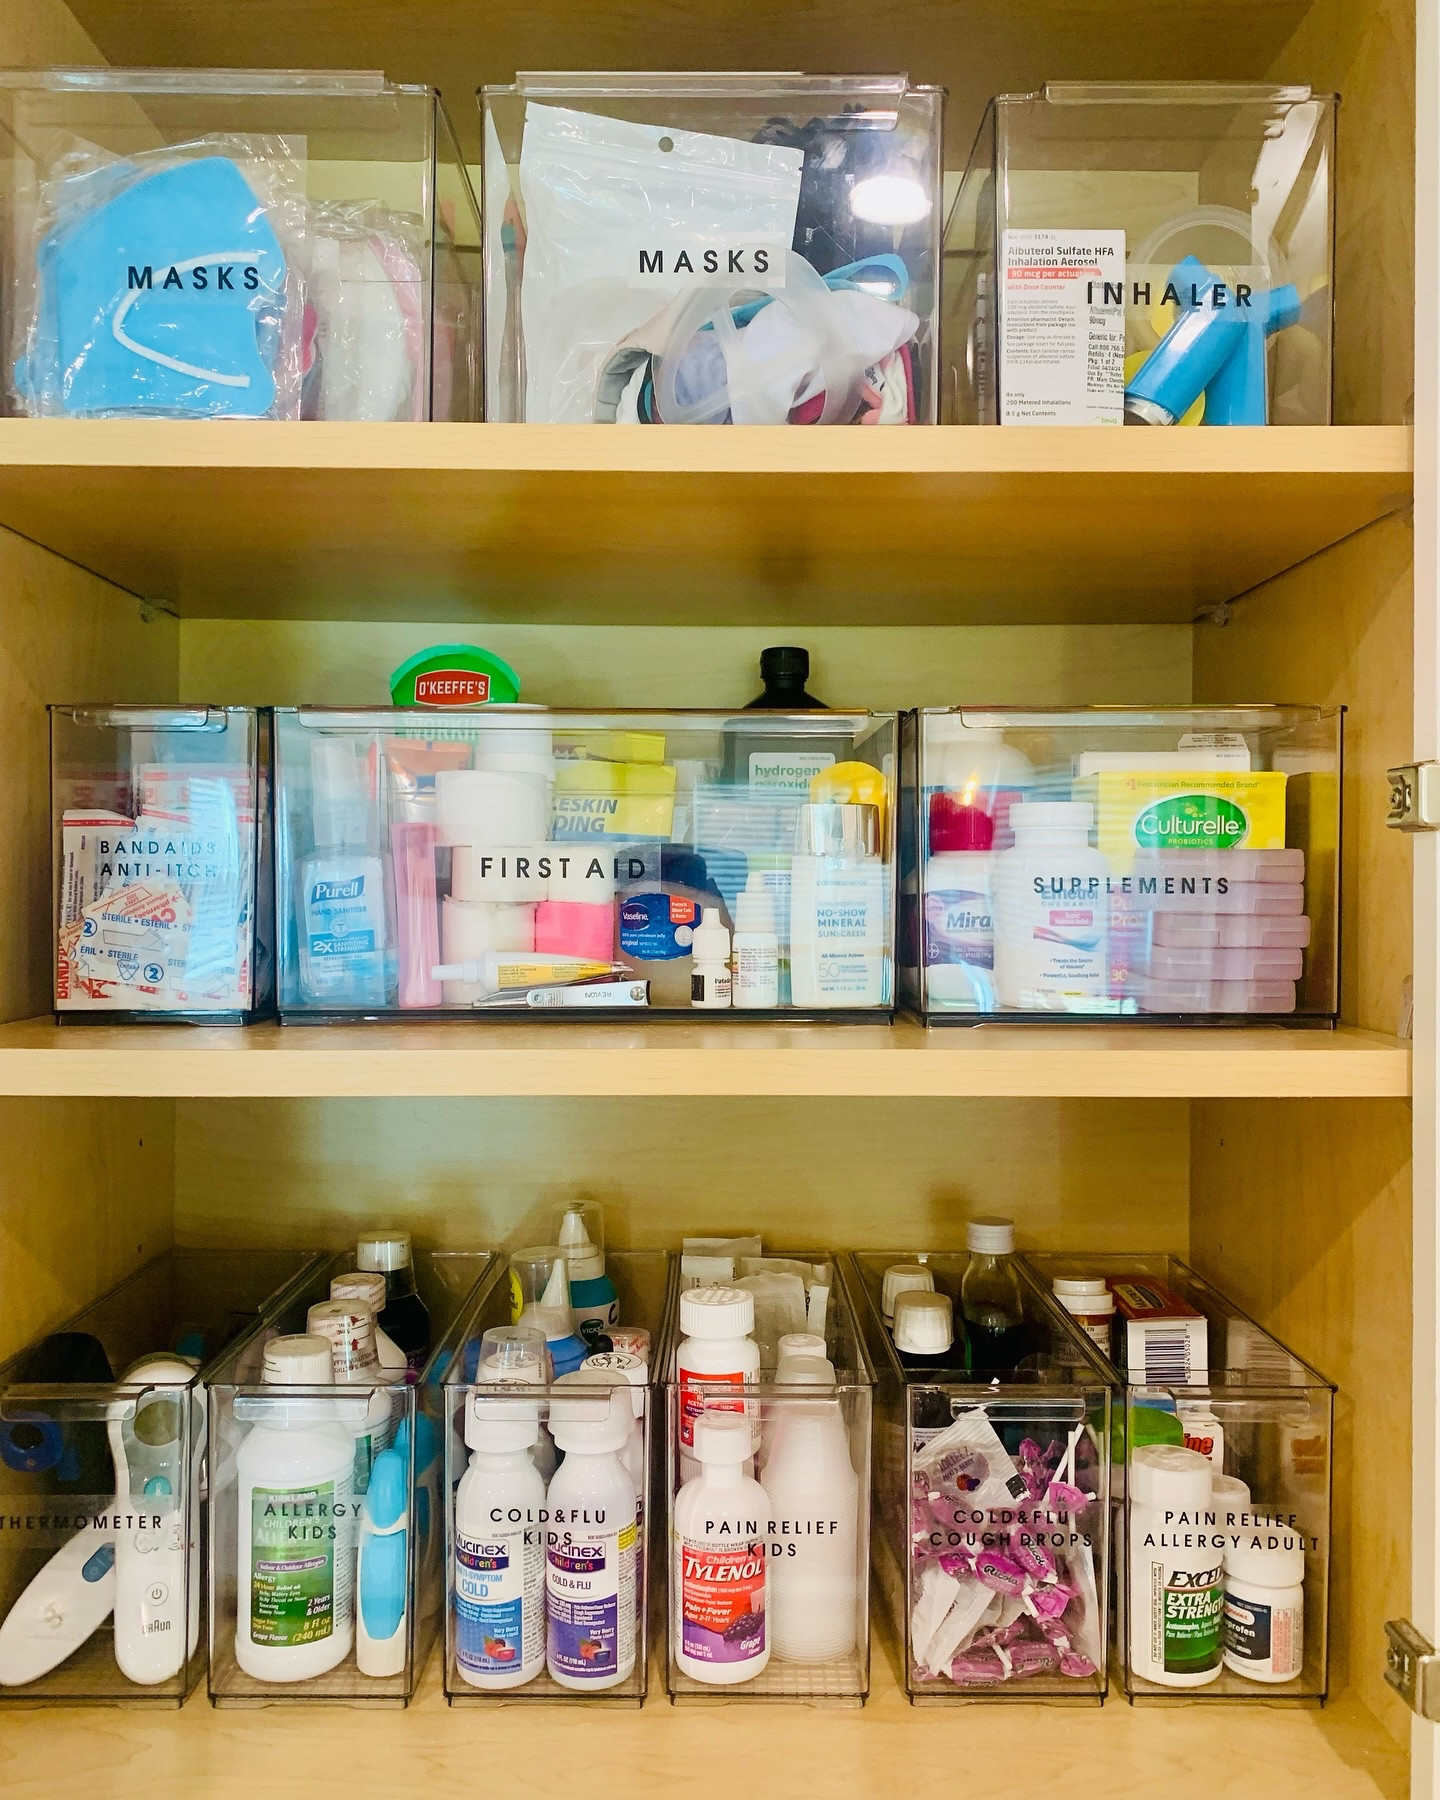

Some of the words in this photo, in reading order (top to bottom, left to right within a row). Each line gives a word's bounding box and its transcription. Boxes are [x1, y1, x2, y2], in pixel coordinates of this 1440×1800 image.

[1008, 246, 1054, 256] Albuterol
[1056, 246, 1092, 256] Sulfate
[1094, 247, 1114, 256] HFA
[639, 250, 769, 273] MASKS
[1007, 257, 1058, 266] Inhalation
[1060, 257, 1098, 266] Aerosol
[128, 266, 260, 290] MASKS
[1024, 271, 1041, 279] mcg
[1042, 271, 1056, 279] per
[1087, 281, 1252, 307] INHALER
[418, 681, 486, 696] O'KEEFFE'S
[755, 764, 821, 778] hydrogen
[1181, 780, 1235, 789] Recommended
[555, 798, 619, 815] ESKIN
[1141, 815, 1240, 835] Culturelle
[100, 840, 217, 855] BANDAIDS
[101, 862, 217, 878] ANTI-ITCH
[481, 857, 570, 879] FIRST
[585, 857, 645, 880] AID
[315, 882, 359, 899] Purell
[1033, 877, 1229, 895] SUPPLEMENTS
[102, 912, 136, 925] STERILE
[622, 912, 649, 921] Vaseline
[816, 909, 867, 918] NO-SHOW
[946, 911, 991, 929] Mira
[817, 918, 867, 928] MINERAL
[818, 930, 867, 938] SUNSCREEN
[149, 967, 159, 980] 2
[818, 962, 841, 978] 50
[264, 1503, 362, 1517] ALLERGY
[490, 1508, 606, 1524] COLD&FLU
[953, 1509, 1069, 1525] COLD&FLU
[0, 1515, 162, 1530] THERMOMETER
[1165, 1511, 1217, 1526] PAIN
[1226, 1512, 1298, 1528] RELIEF
[288, 1525, 337, 1540] KIDS
[705, 1520, 758, 1535] PAIN
[767, 1520, 838, 1535] RELIEF
[523, 1531, 573, 1546] KIDS
[929, 1531, 1011, 1547] COUGH
[1020, 1532, 1092, 1548] DROPS
[1143, 1533, 1241, 1549] ALLERGY
[1250, 1536, 1319, 1551] ADULT
[747, 1543, 797, 1557] KIDS
[685, 1555, 762, 1582] TYLENOL
[984, 1565, 1019, 1587] Ricola
[253, 1572, 277, 1584] Allergy
[552, 1573, 568, 1587] COLD
[569, 1579, 575, 1589] &
[576, 1581, 592, 1590] FLU
[462, 1578, 489, 1597] COLD
[307, 1598, 313, 1607] 2
[314, 1593, 331, 1605] Years
[1166, 1591, 1212, 1607] EXTRA
[306, 1607, 313, 1616] &
[313, 1602, 331, 1614] Older
[685, 1601, 701, 1613] Pain
[706, 1607, 733, 1616] Fever
[684, 1610, 699, 1620] Ages
[712, 1616, 730, 1624] Years
[303, 1621, 310, 1631] 8
[252, 1631, 269, 1641] Grape
[269, 1633, 288, 1641] Flavor
[292, 1630, 314, 1642] (240
[741, 1636, 761, 1651] Grape
